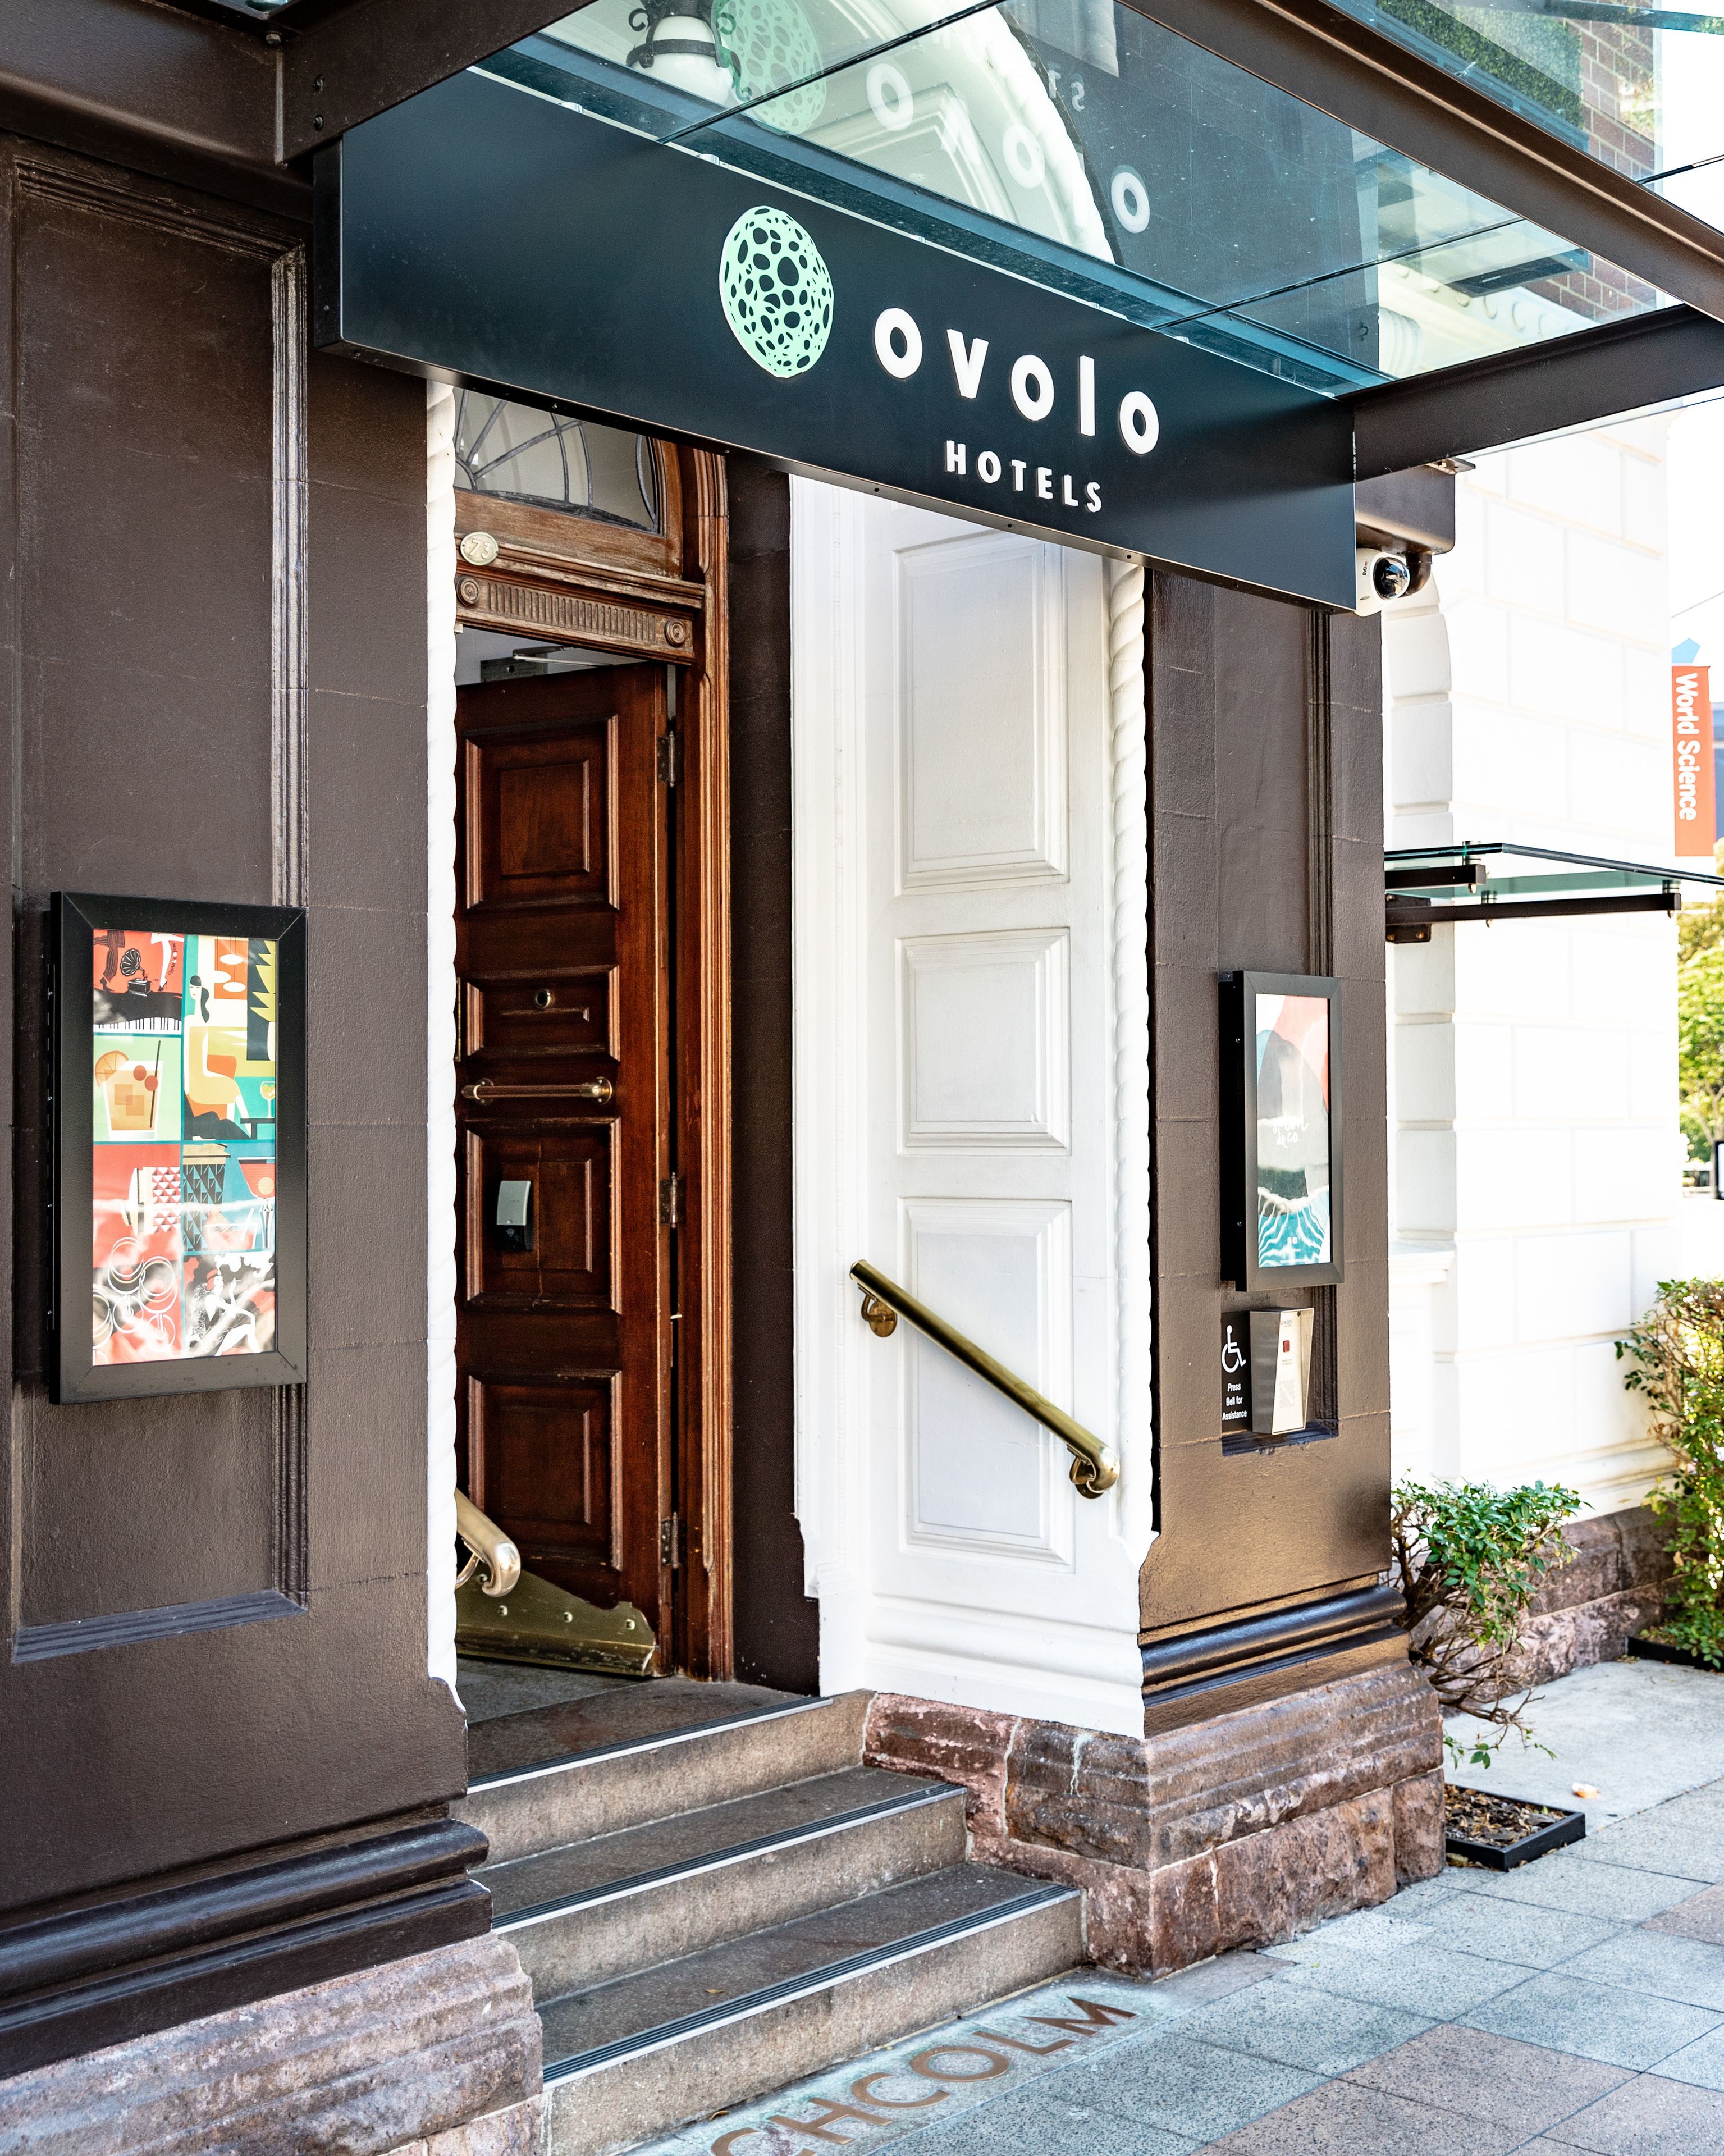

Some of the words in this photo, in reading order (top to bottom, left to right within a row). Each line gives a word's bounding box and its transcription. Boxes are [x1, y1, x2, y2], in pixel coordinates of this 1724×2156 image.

[874, 308, 1160, 455] ovolo
[946, 440, 1102, 513] HOTELS
[469, 539, 492, 559] 73
[1675, 672, 1700, 735] World
[1677, 739, 1701, 821] Science
[1222, 1410, 1247, 1420] Assistance
[1226, 1396, 1235, 1406] Bell
[1227, 1383, 1241, 1392] Press
[710, 1997, 1140, 2156] CHCOLM
